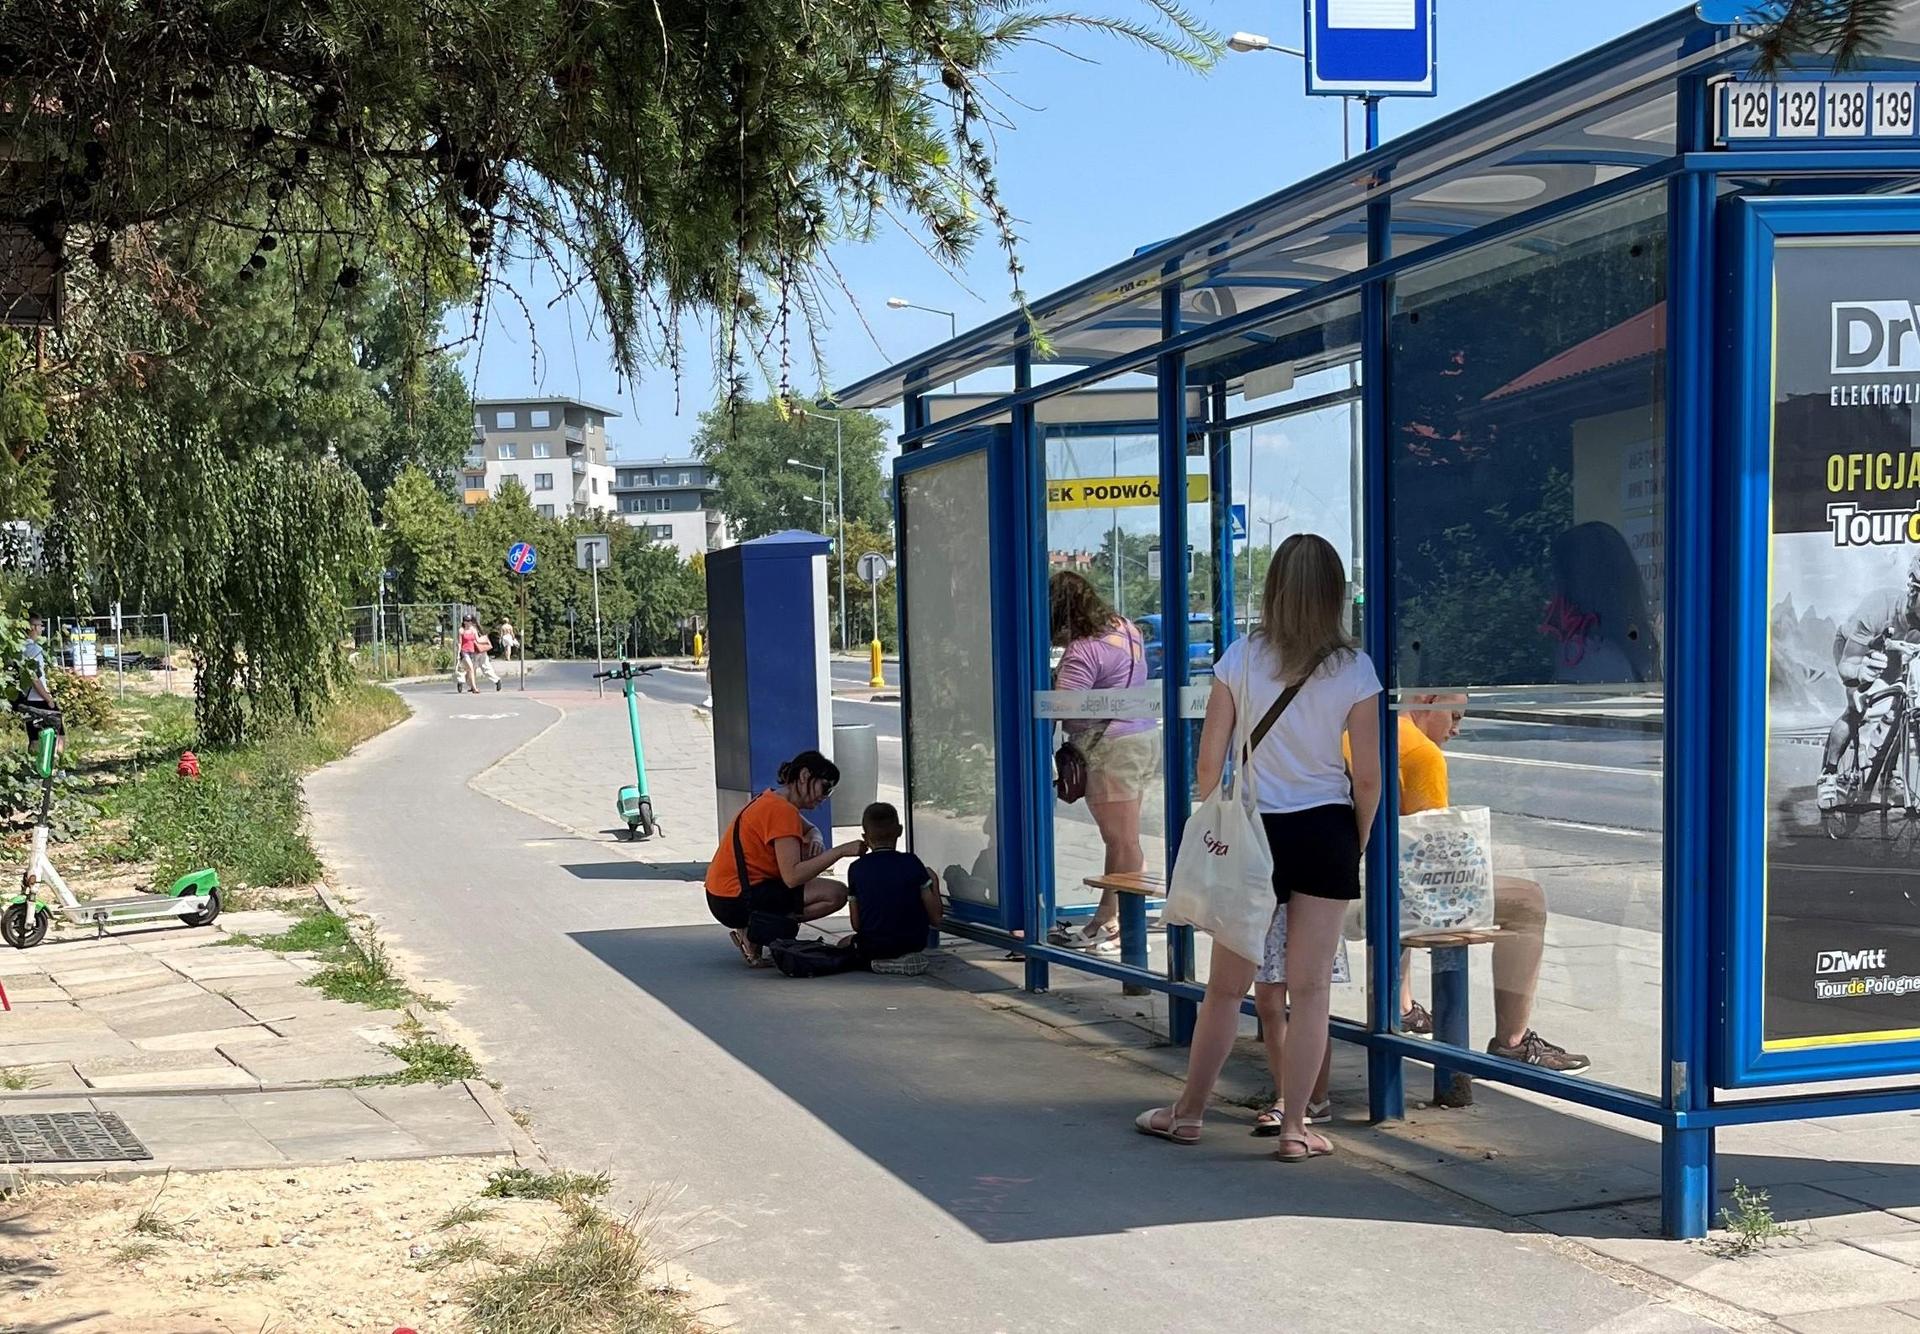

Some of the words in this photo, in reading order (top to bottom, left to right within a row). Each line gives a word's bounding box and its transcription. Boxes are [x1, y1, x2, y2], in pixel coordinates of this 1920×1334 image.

[1731, 92, 1769, 128] 129
[1779, 91, 1816, 127] 132
[1827, 92, 1864, 128] 138
[1875, 91, 1912, 127] 139
[1832, 301, 1920, 371] Dr
[1827, 452, 1920, 492] OFICJA
[1420, 870, 1476, 886] ACTION
[1816, 949, 1886, 973] DrWitt
